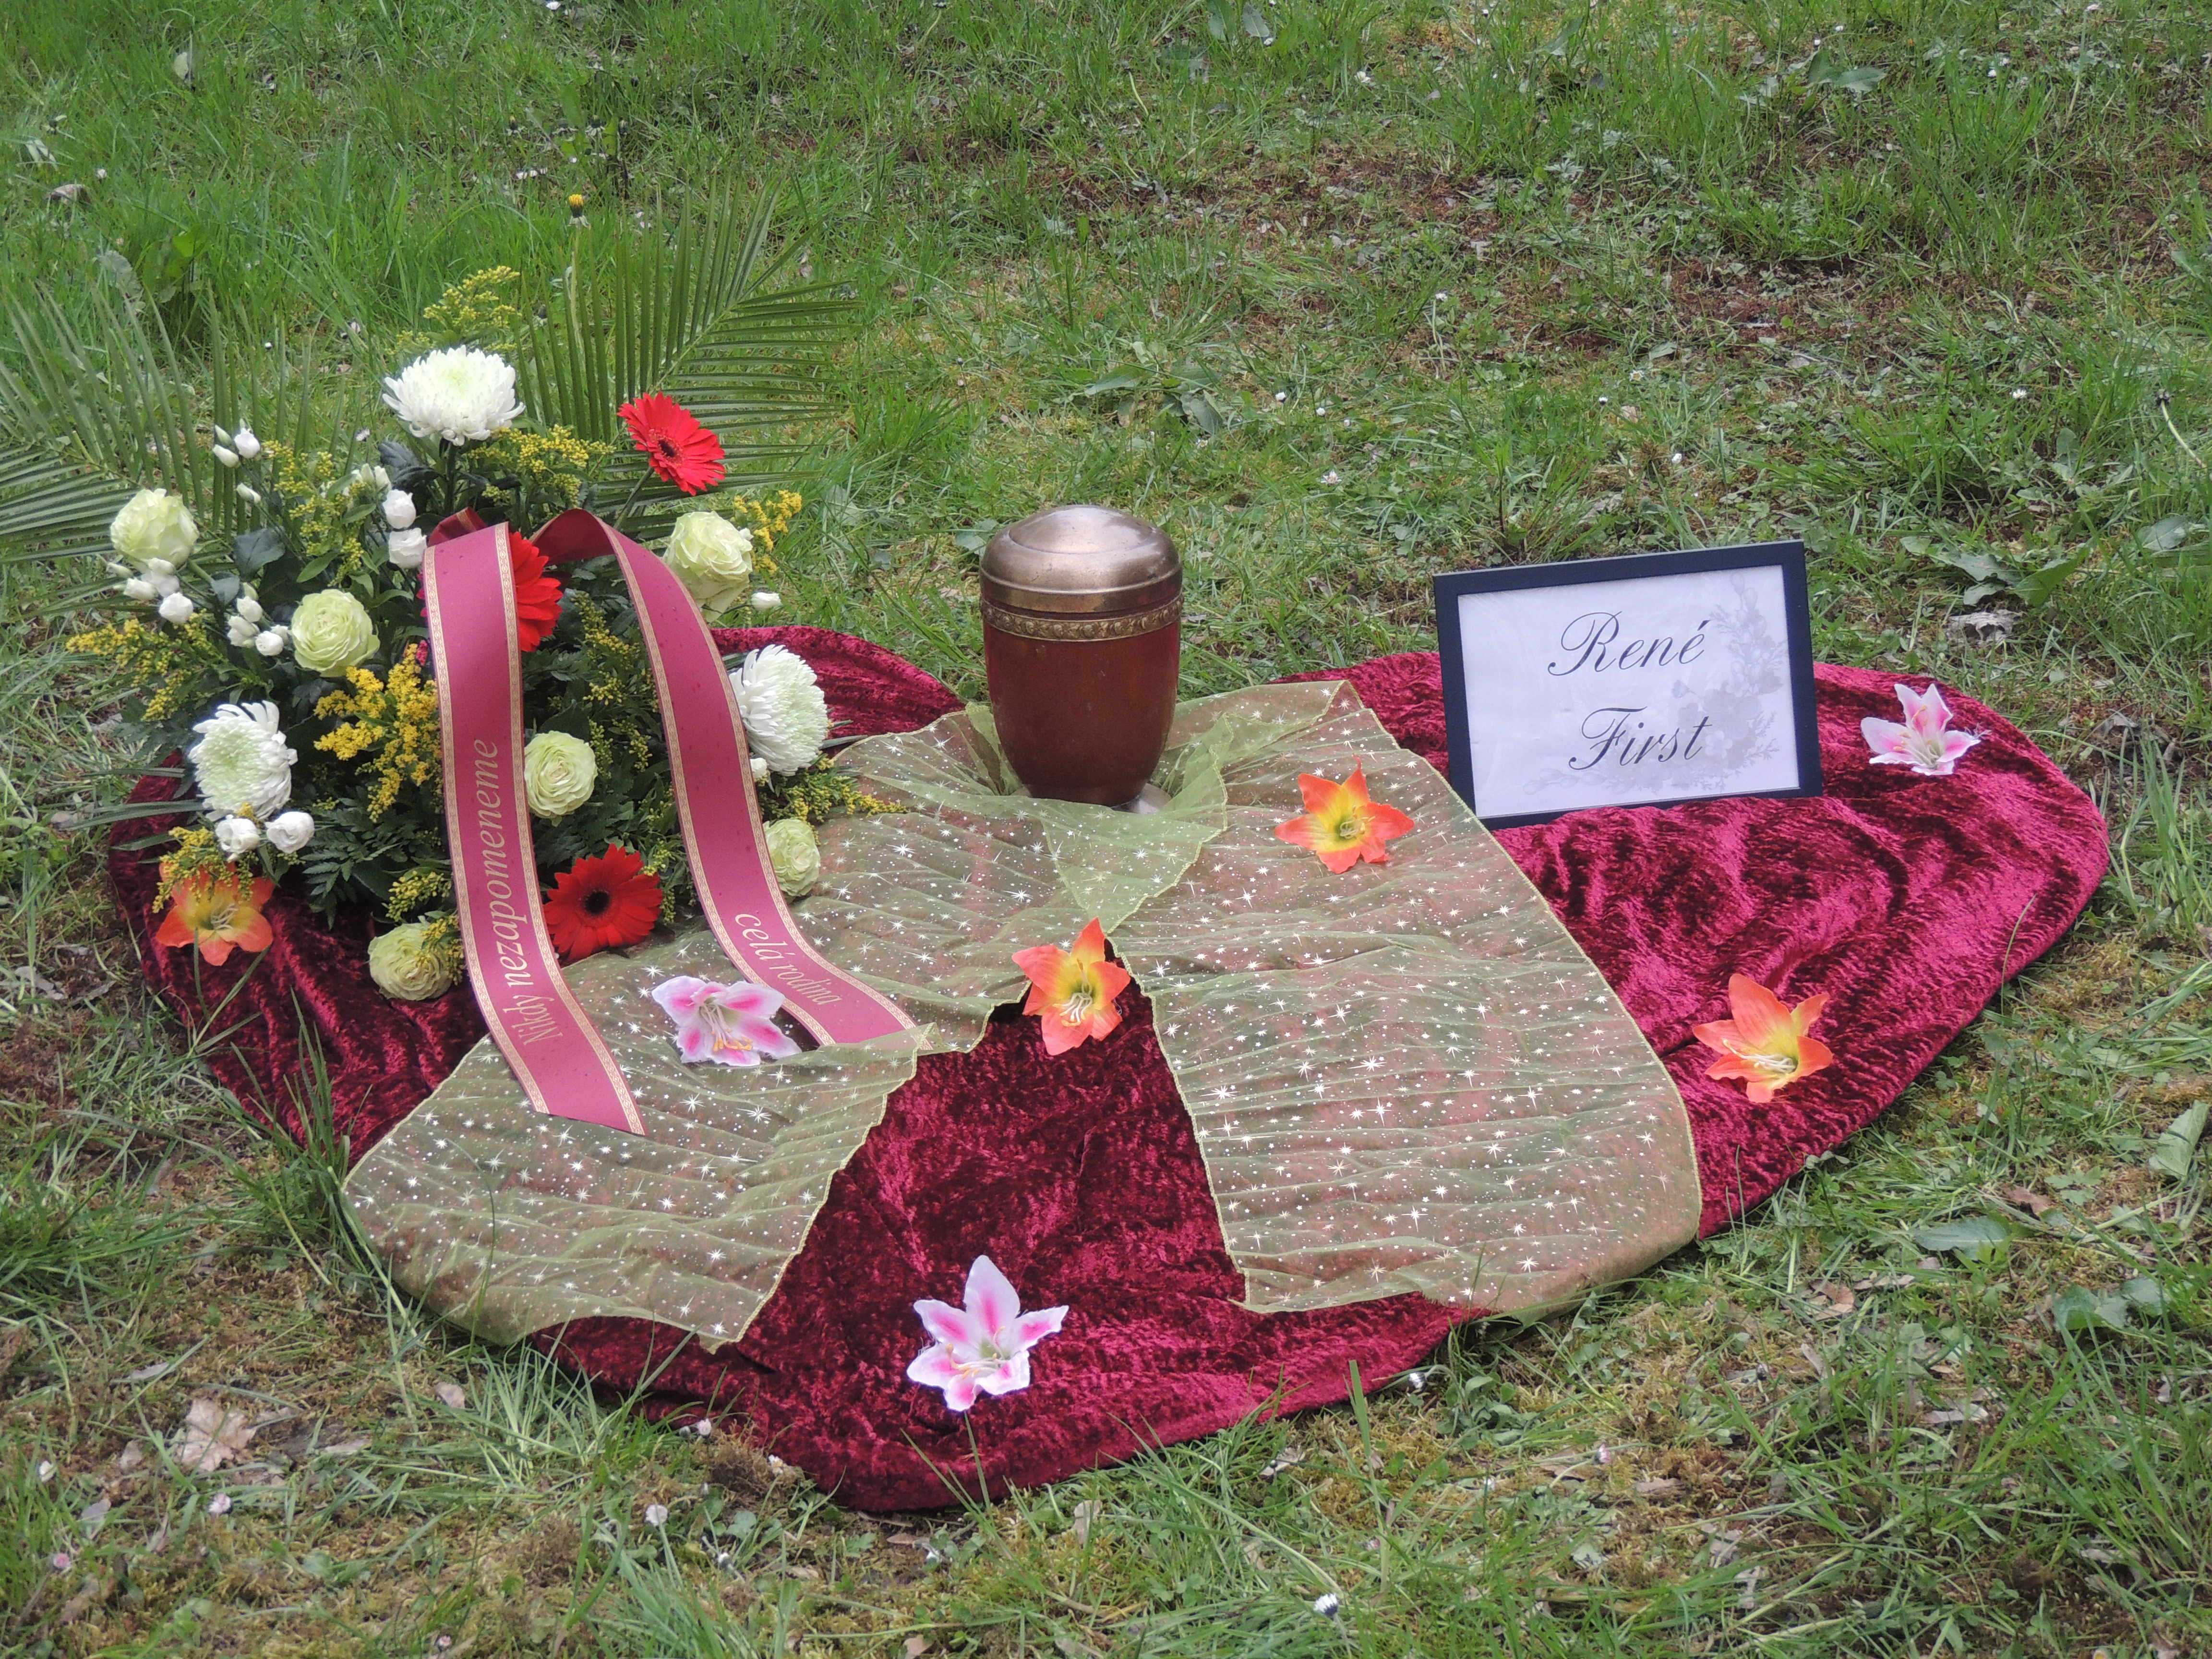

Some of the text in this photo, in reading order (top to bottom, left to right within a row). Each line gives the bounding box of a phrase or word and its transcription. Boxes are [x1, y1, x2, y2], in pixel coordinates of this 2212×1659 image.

[1548, 610, 1710, 676] René
[1568, 706, 1712, 770] First
[474, 738, 563, 1047] Nikdy nezapomeneme
[734, 913, 842, 1005] celá rodina
